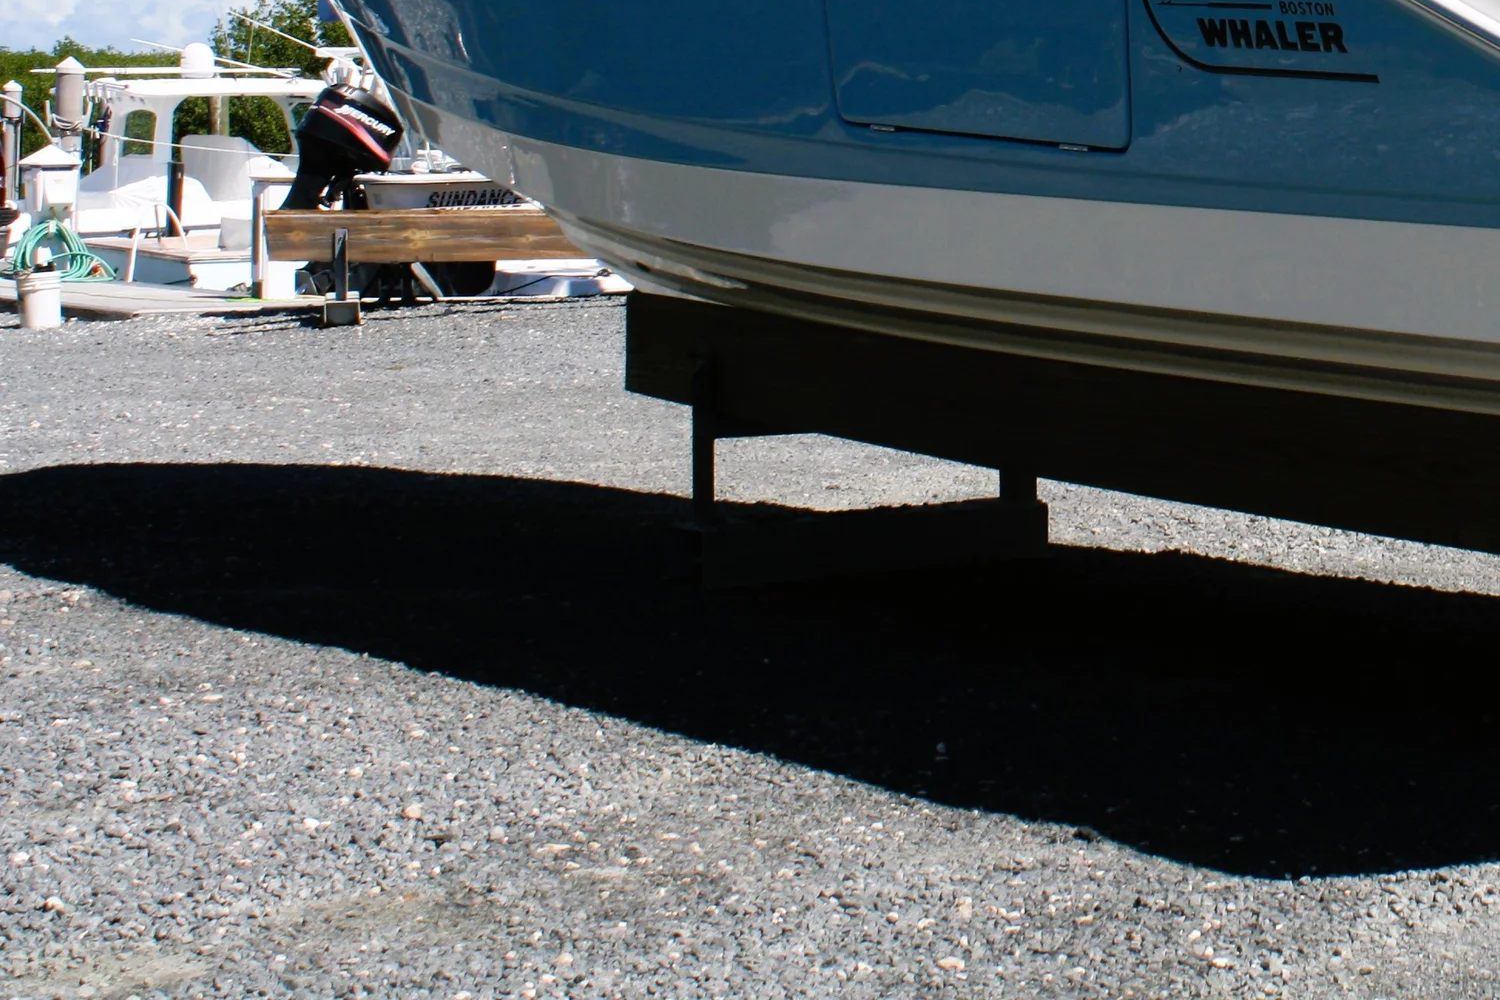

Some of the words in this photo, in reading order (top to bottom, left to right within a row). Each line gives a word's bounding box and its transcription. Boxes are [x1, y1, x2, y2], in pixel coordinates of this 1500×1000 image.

[1278, 0, 1335, 17] BOSTON
[1197, 17, 1349, 54] WHALER
[334, 104, 396, 137] MERCURY
